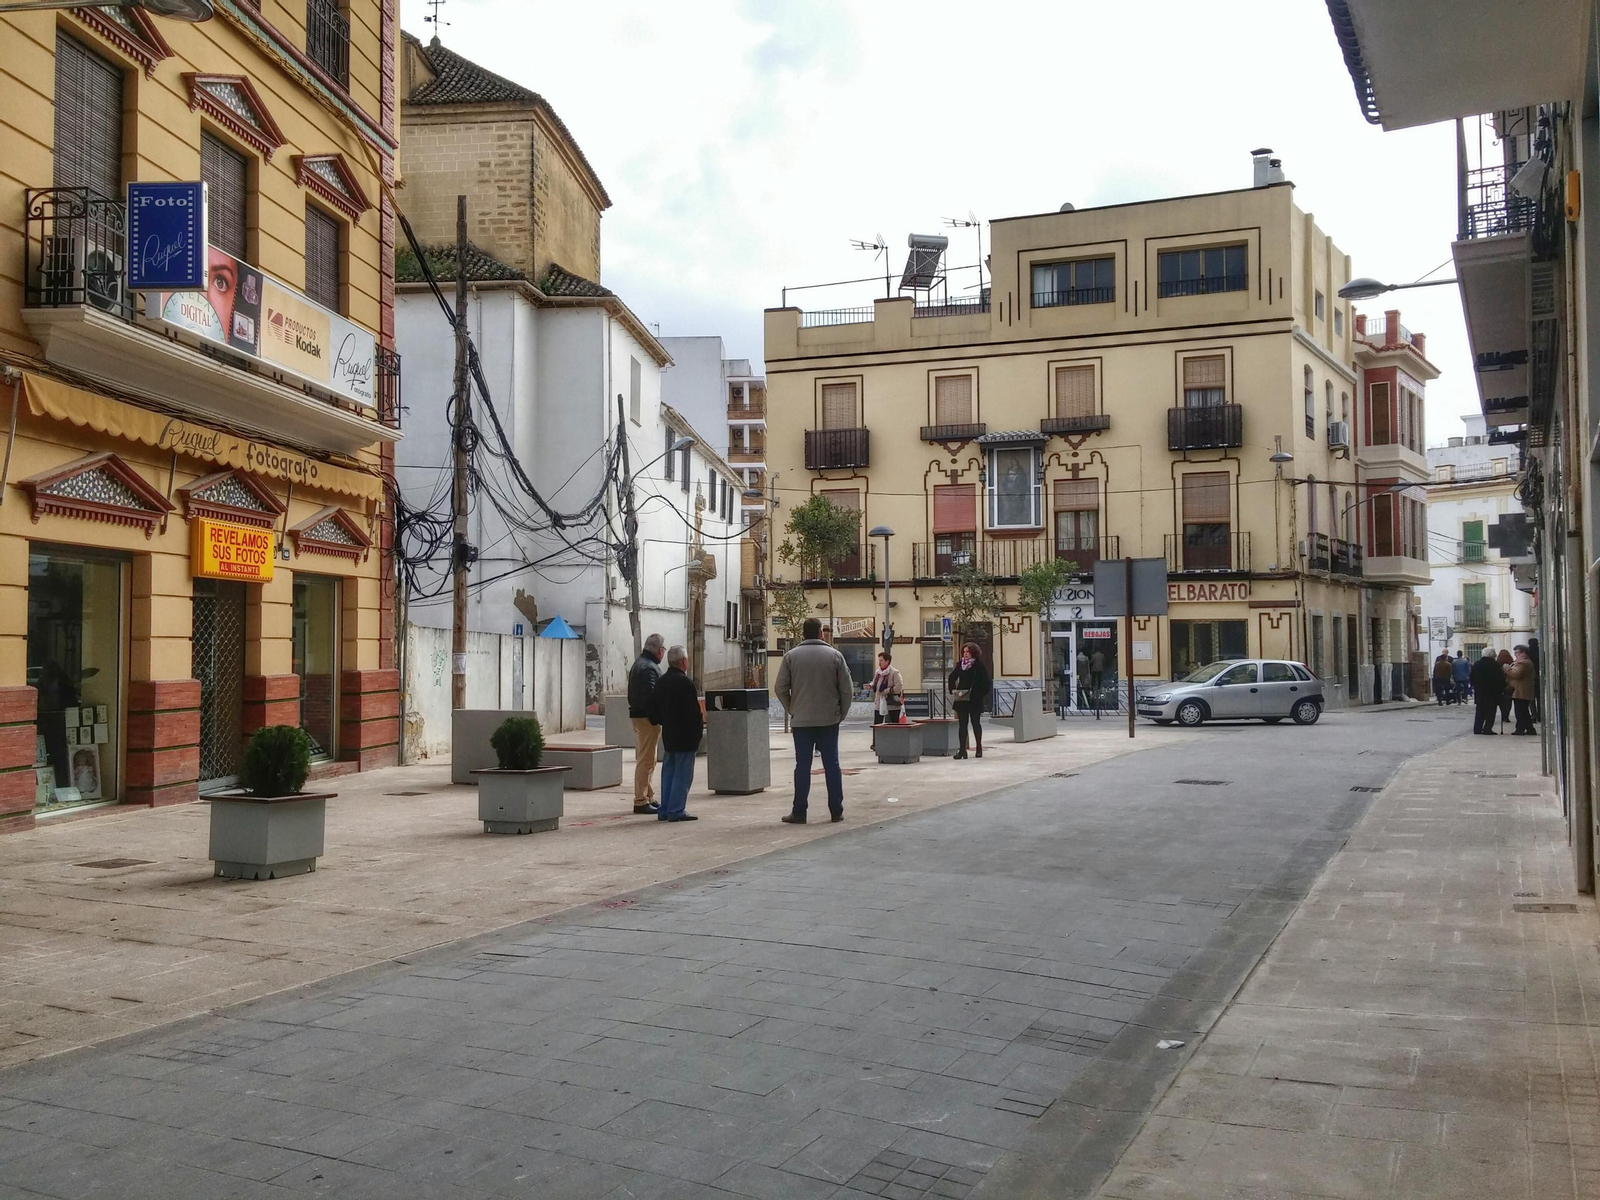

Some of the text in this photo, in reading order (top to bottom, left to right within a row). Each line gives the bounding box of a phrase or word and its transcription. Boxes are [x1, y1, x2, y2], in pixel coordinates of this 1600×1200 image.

[139, 196, 188, 207] Foto
[180, 303, 212, 327] DIGITAL
[284, 316, 317, 341] PRODUCTOS
[295, 334, 322, 359] Kodak
[210, 527, 269, 550] REVELAMOS
[212, 544, 232, 561] SUS
[236, 547, 266, 565] FOTOS
[220, 562, 259, 574] AL INSTANTE
